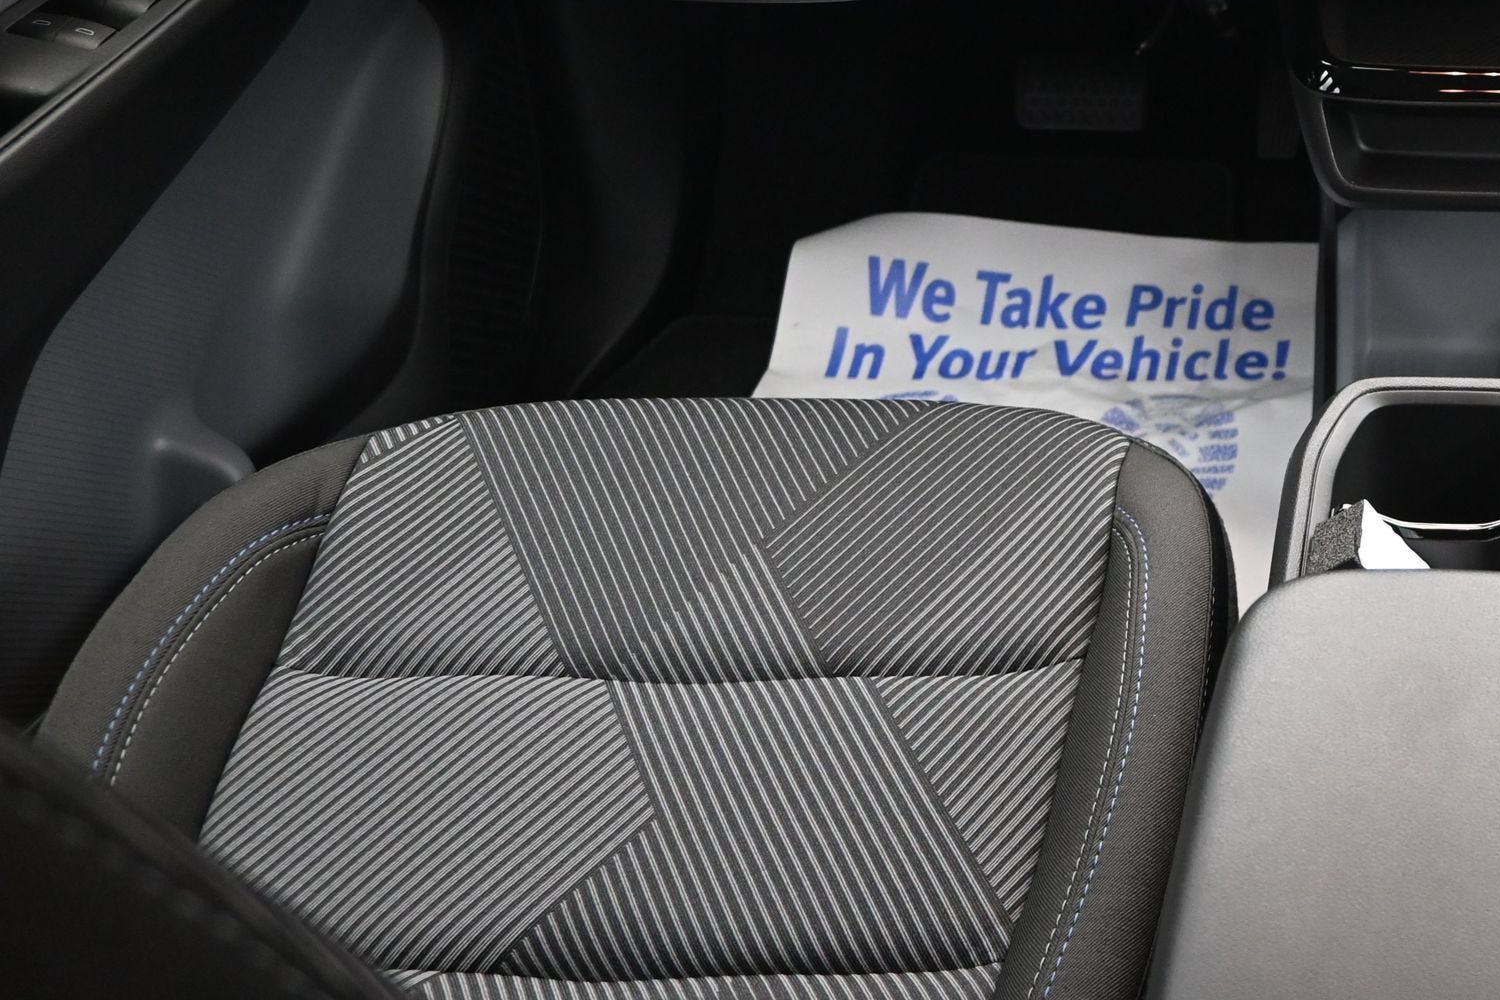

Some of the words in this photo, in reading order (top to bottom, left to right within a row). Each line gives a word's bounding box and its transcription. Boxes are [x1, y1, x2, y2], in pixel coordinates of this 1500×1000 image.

[868, 256, 956, 323] We
[977, 270, 1106, 329] Take
[1125, 284, 1275, 332] Pride
[824, 326, 885, 379] In
[909, 334, 1037, 381] Your
[1054, 335, 1291, 382] Vehicle!
